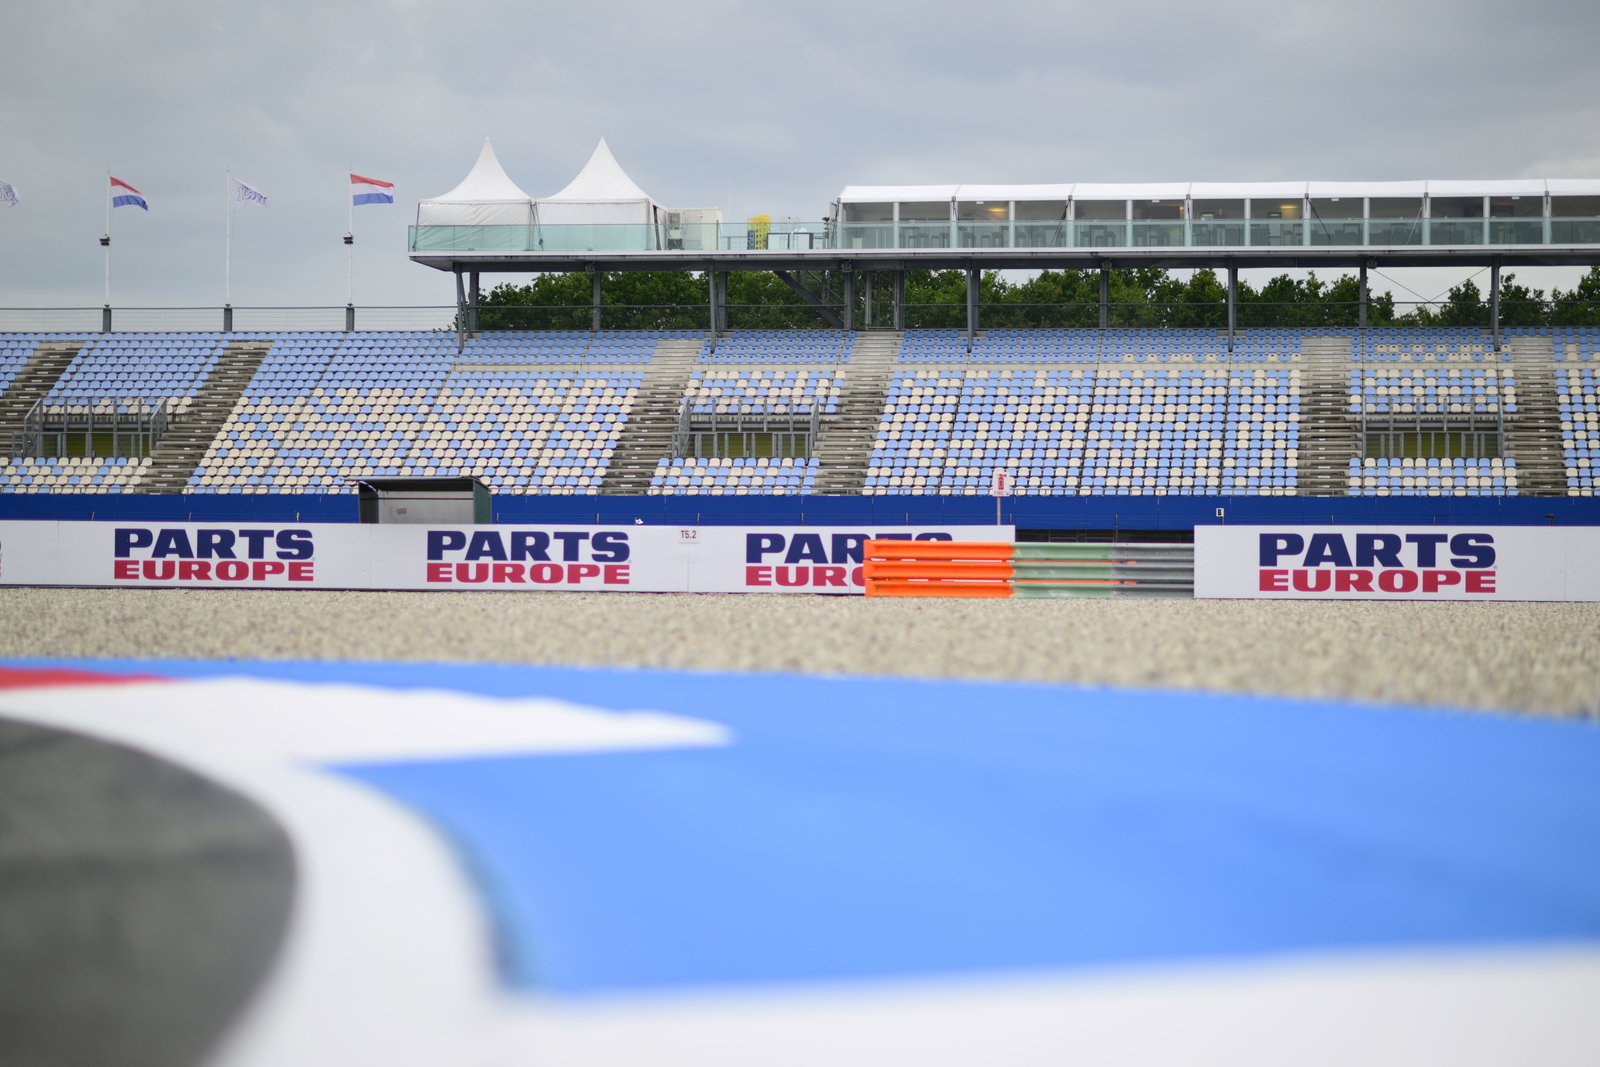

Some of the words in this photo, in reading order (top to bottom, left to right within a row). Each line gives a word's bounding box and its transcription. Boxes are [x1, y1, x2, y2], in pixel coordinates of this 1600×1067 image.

[115, 528, 313, 560] PARTS
[428, 531, 629, 562] PARTS
[681, 530, 697, 539] T5.2
[747, 533, 952, 564] PAR
[1260, 534, 1496, 569] PARTS
[114, 560, 313, 582] EUROPE
[427, 563, 629, 585] EUROPE
[1260, 570, 1496, 594] EUROPE
